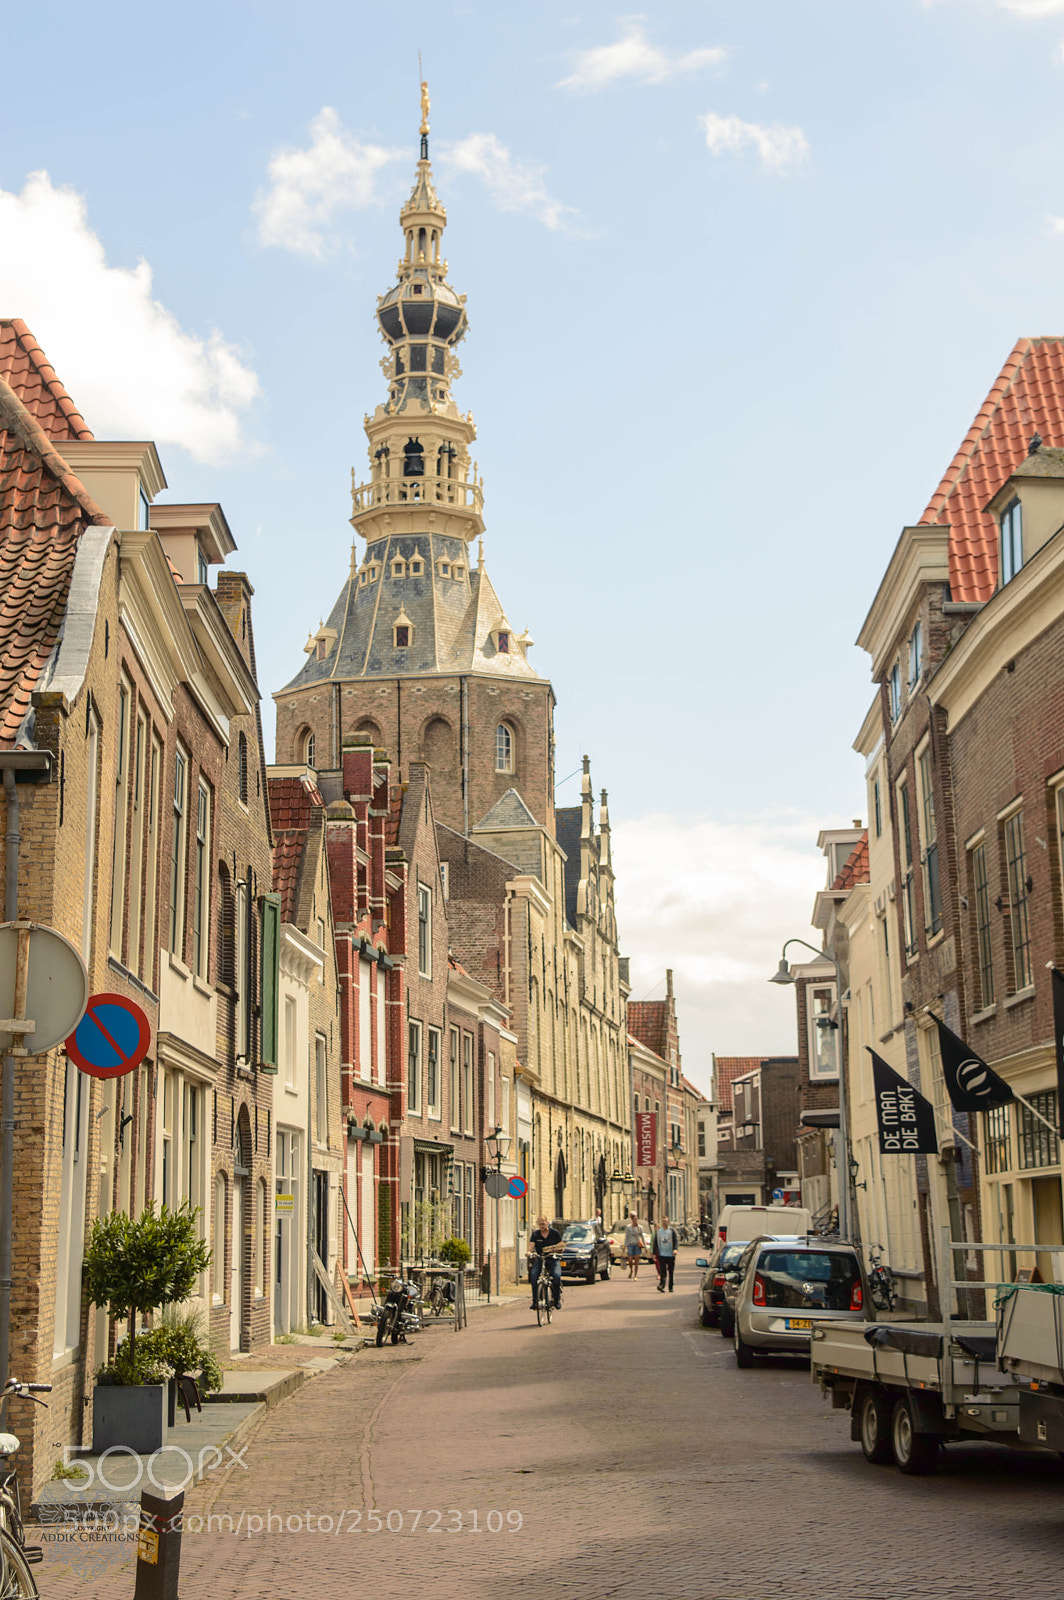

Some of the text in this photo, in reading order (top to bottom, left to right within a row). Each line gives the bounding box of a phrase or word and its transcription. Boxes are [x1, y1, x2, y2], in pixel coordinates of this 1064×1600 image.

[641, 1114, 652, 1165] MUSEUM
[880, 1091, 901, 1149] DE MAN
[897, 1085, 919, 1149] DIE BAKT
